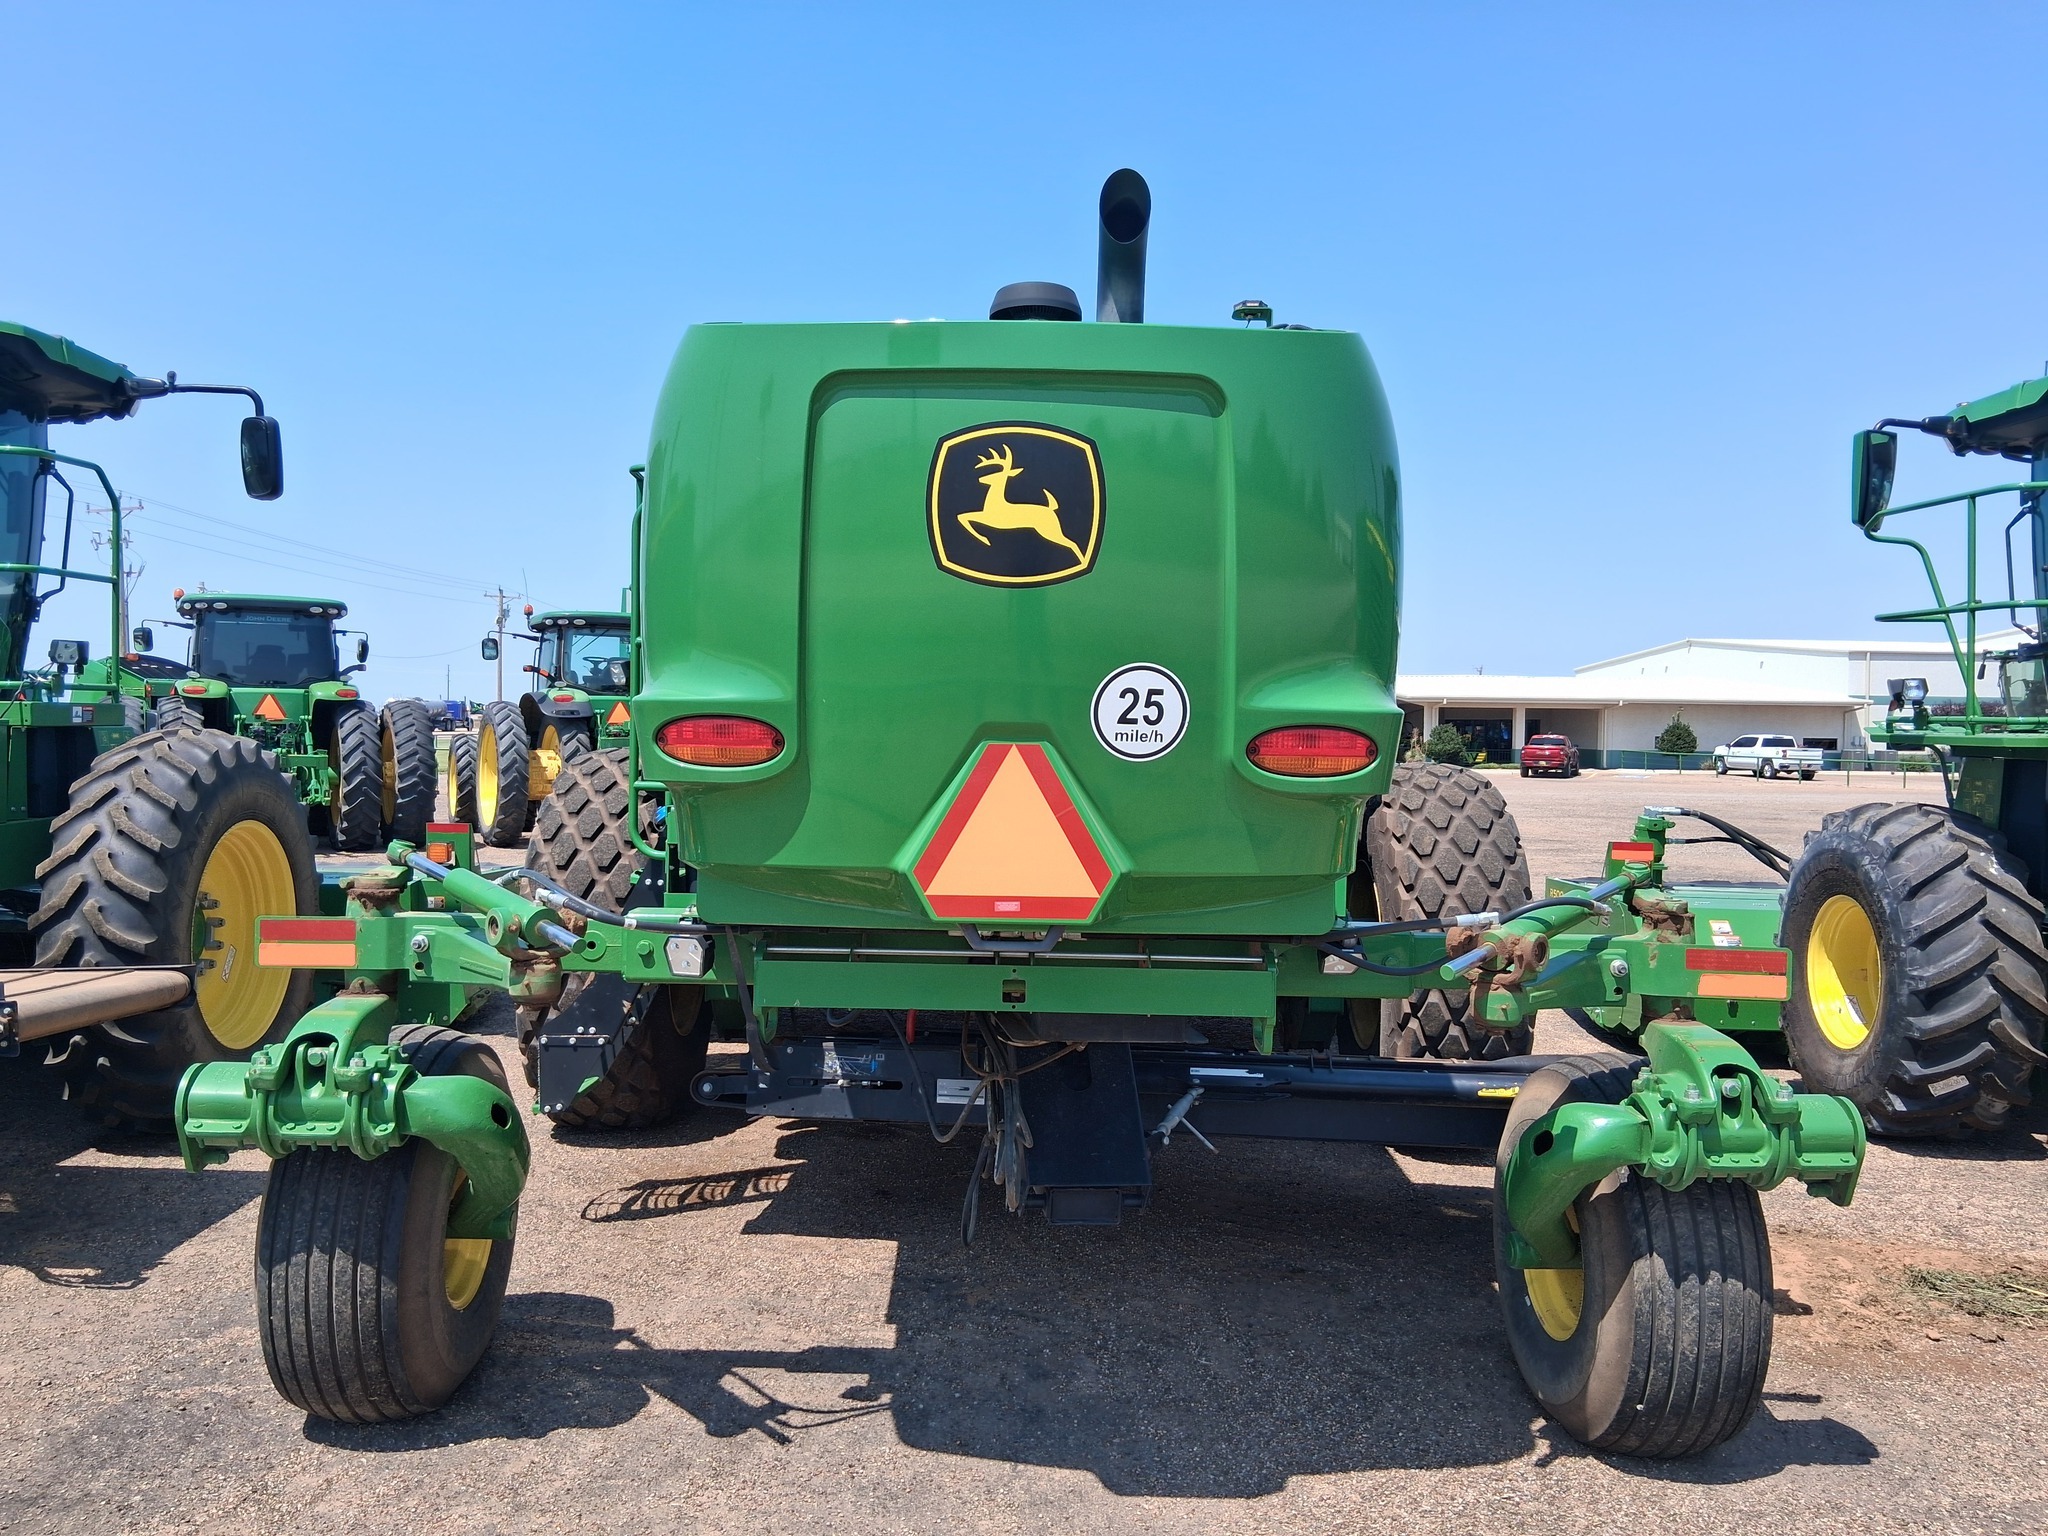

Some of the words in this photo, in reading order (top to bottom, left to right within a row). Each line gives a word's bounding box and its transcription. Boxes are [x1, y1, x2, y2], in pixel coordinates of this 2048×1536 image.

[266, 615, 292, 623] DEERE
[1116, 687, 1164, 726] 25
[1114, 729, 1164, 743] mile/h
